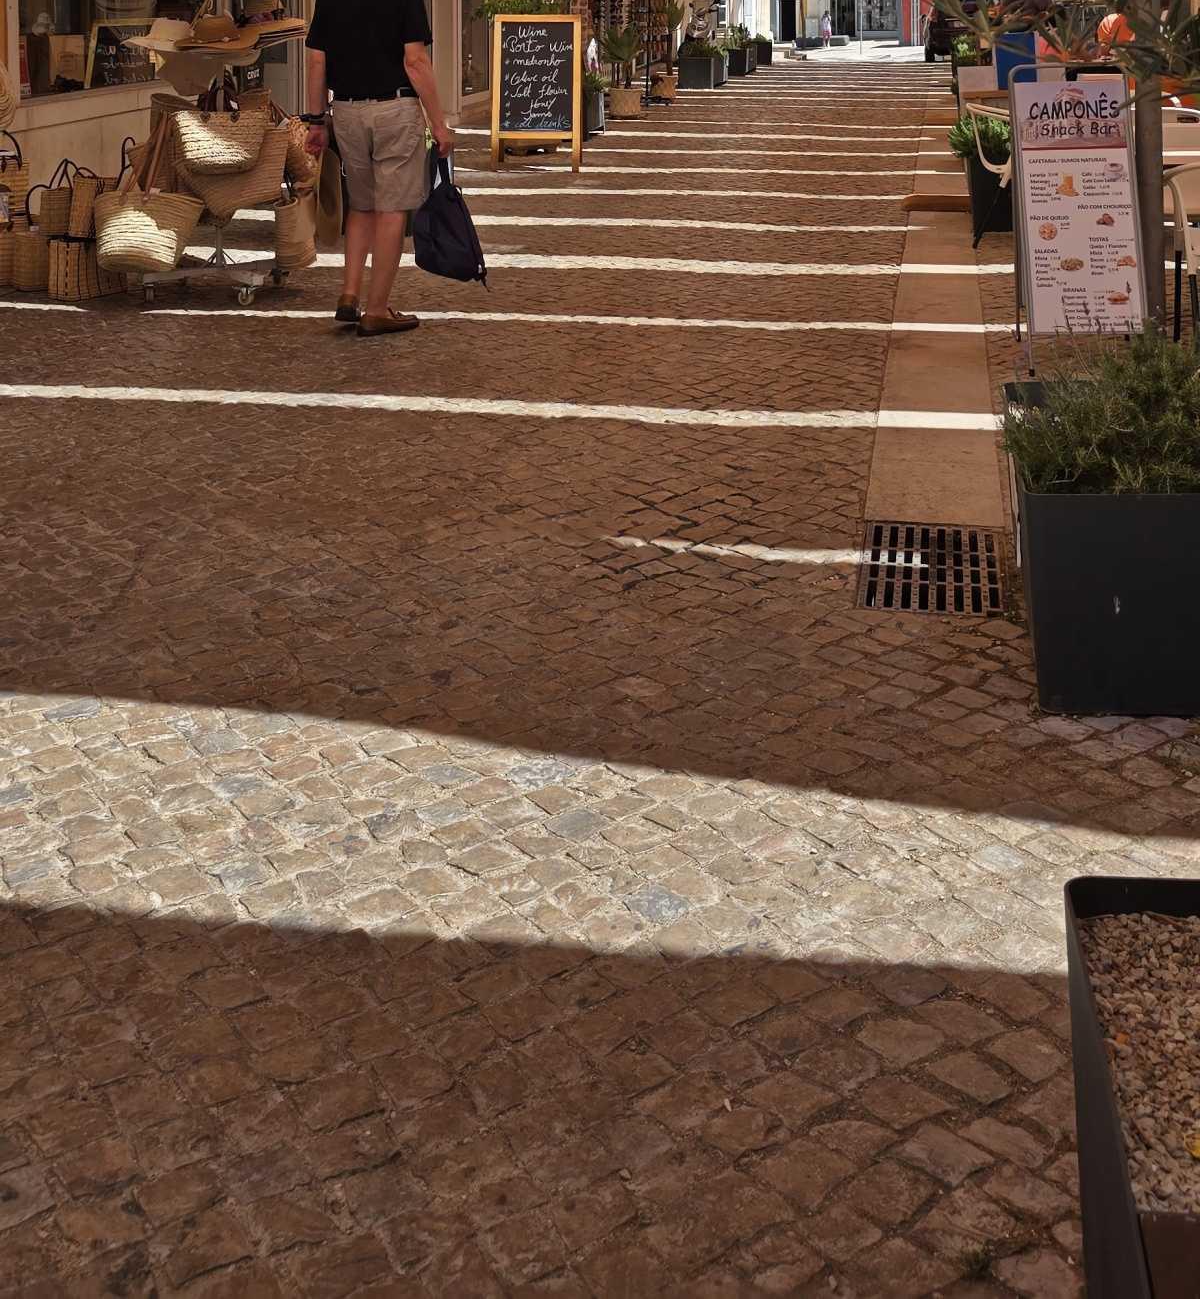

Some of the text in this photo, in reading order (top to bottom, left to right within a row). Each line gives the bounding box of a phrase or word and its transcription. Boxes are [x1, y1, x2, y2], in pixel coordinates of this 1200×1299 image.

[518, 25, 548, 38] Wine
[541, 68, 560, 84] oil
[1029, 92, 1120, 120] CAMPONÊS
[1040, 121, 1117, 136] Snack Bar
